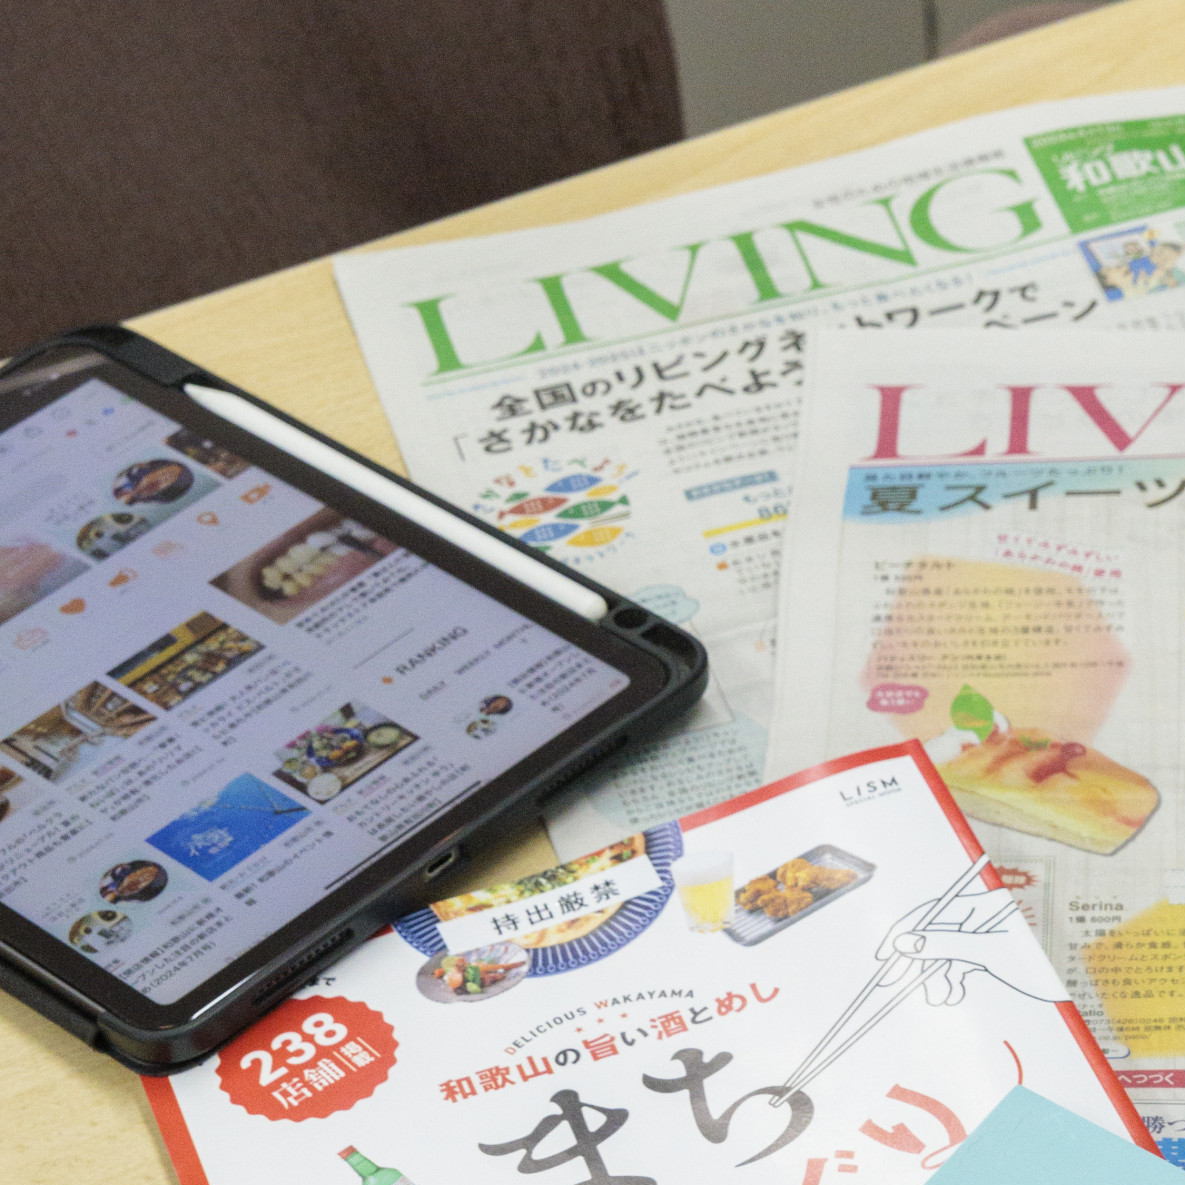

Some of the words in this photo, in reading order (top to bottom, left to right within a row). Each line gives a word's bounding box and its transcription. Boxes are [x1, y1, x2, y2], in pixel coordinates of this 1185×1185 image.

[404, 167, 1044, 376] LIVING
[838, 775, 899, 802] LISM
[490, 879, 620, 936] 持出厳禁
[1068, 900, 1125, 912] Serina
[240, 1012, 348, 1087] 238
[438, 981, 781, 1104] 和歌山の旨い酒とめし
[503, 1006, 588, 1057] DELICIOUS
[593, 989, 696, 1011] WAKAYAMA
[272, 1057, 347, 1110] 店舗
